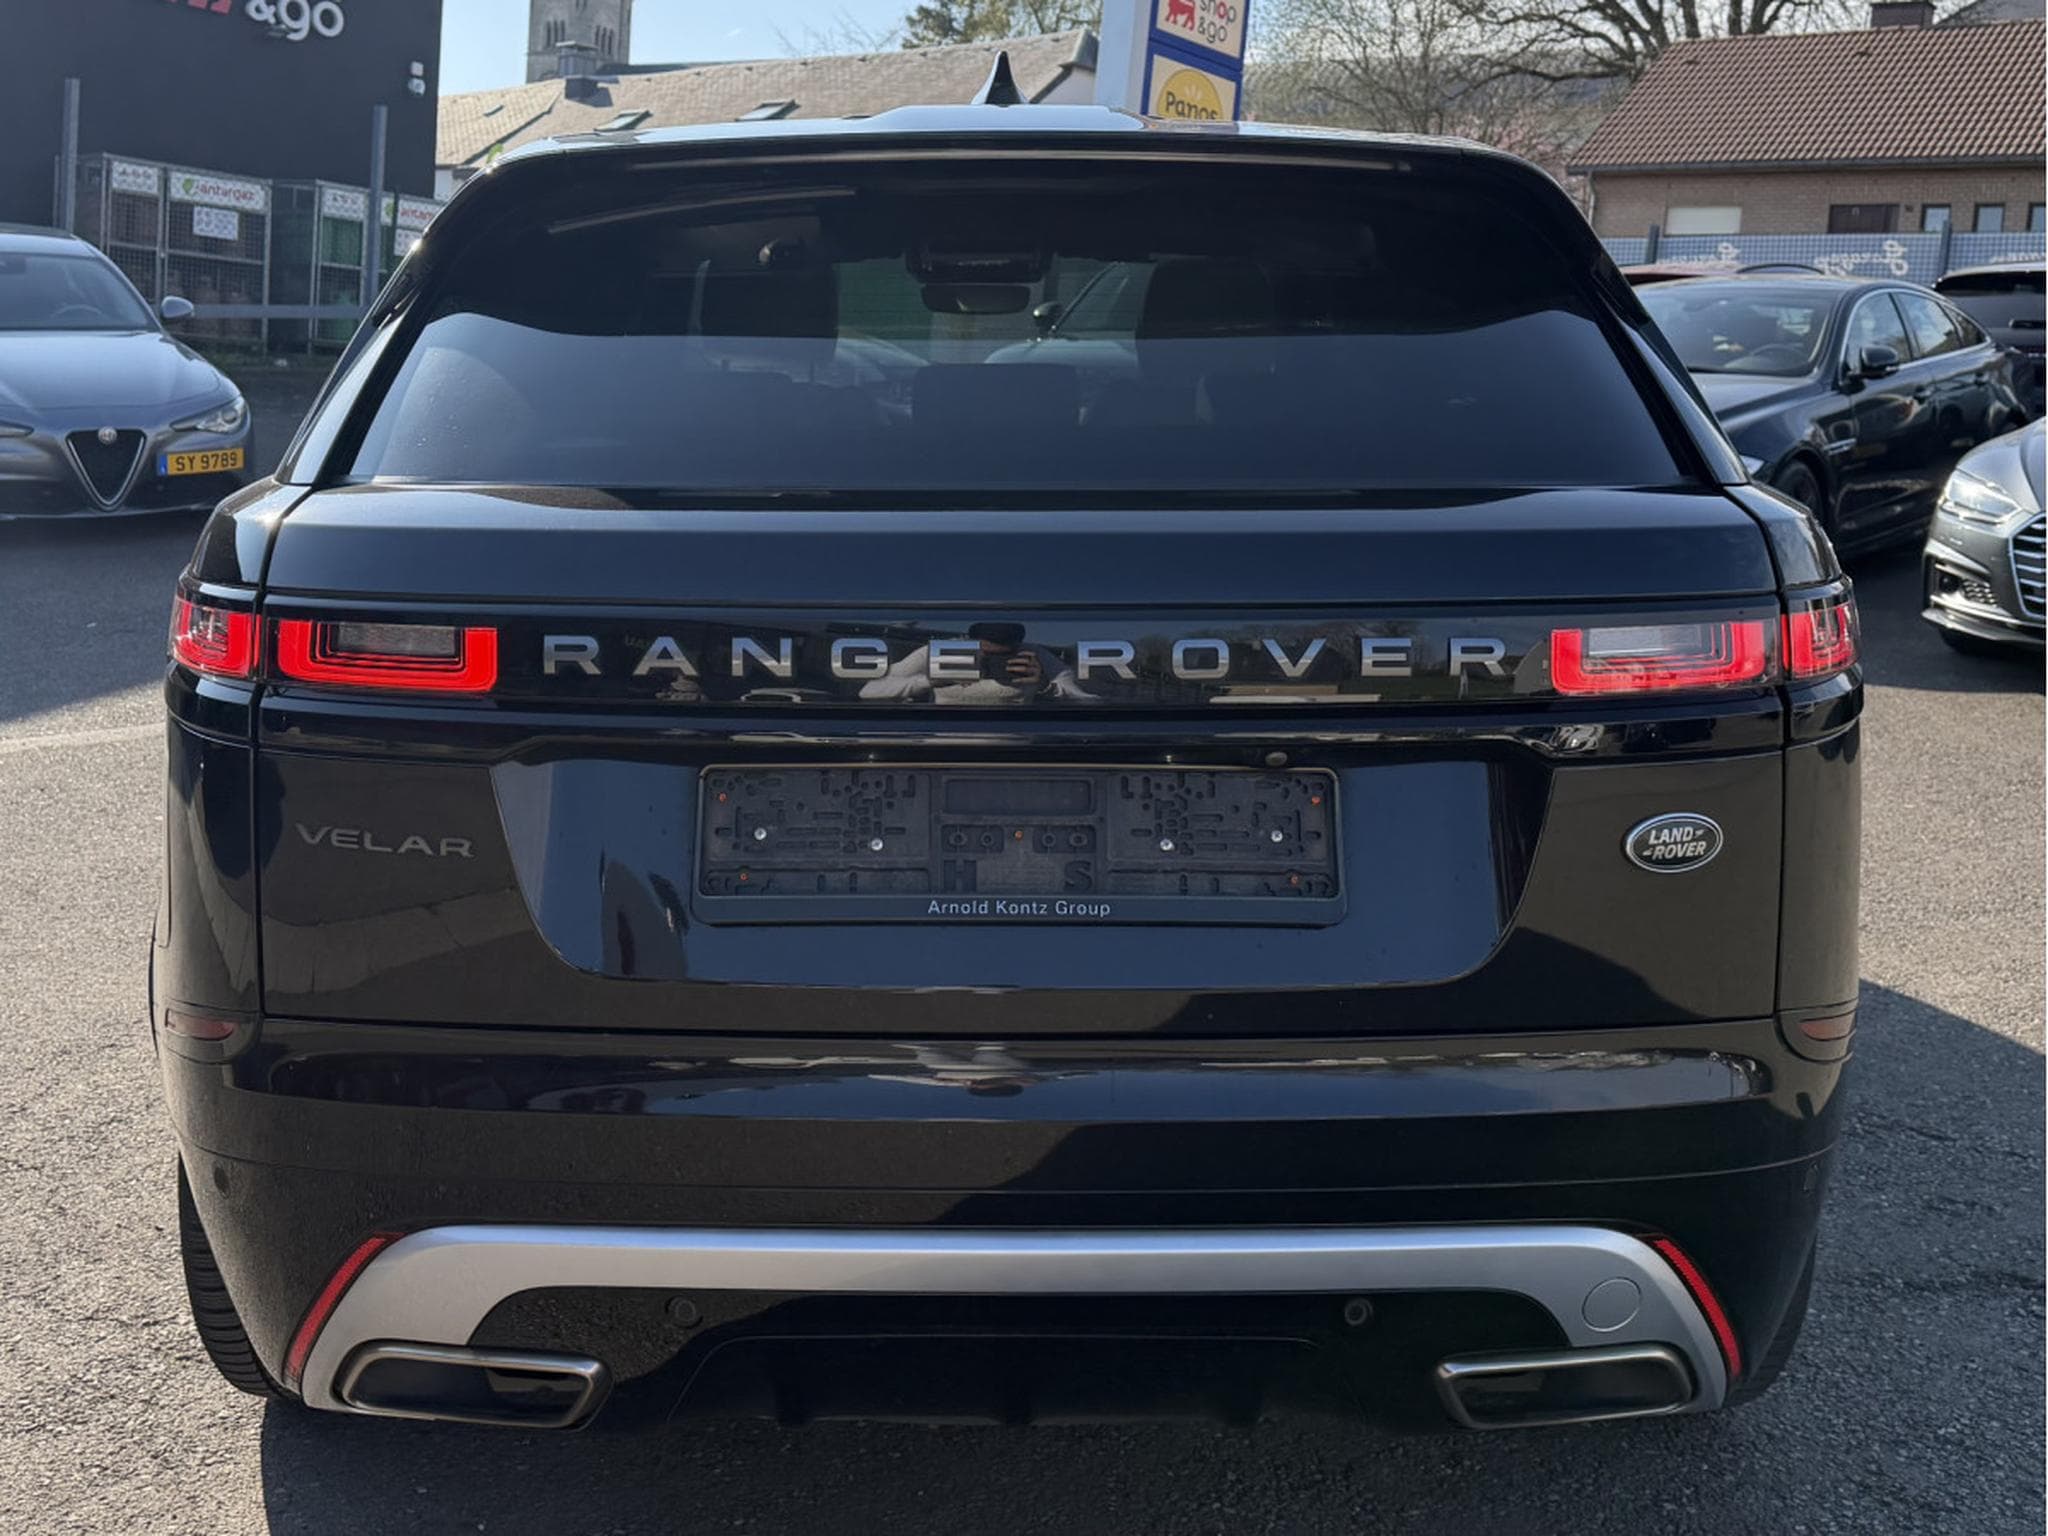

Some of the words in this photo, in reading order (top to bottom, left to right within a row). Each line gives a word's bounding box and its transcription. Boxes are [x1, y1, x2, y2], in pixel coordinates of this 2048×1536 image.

[175, 455, 195, 472] SY
[200, 451, 238, 470] 9789
[543, 634, 981, 681] RANGE
[1076, 637, 1508, 681] ROVER
[296, 822, 475, 858] VELAR
[1648, 826, 1694, 846] LAND
[1651, 840, 1708, 861] ROVER
[927, 899, 989, 916] Arnold
[995, 900, 1048, 916] Kontz
[1054, 900, 1111, 919] Group
